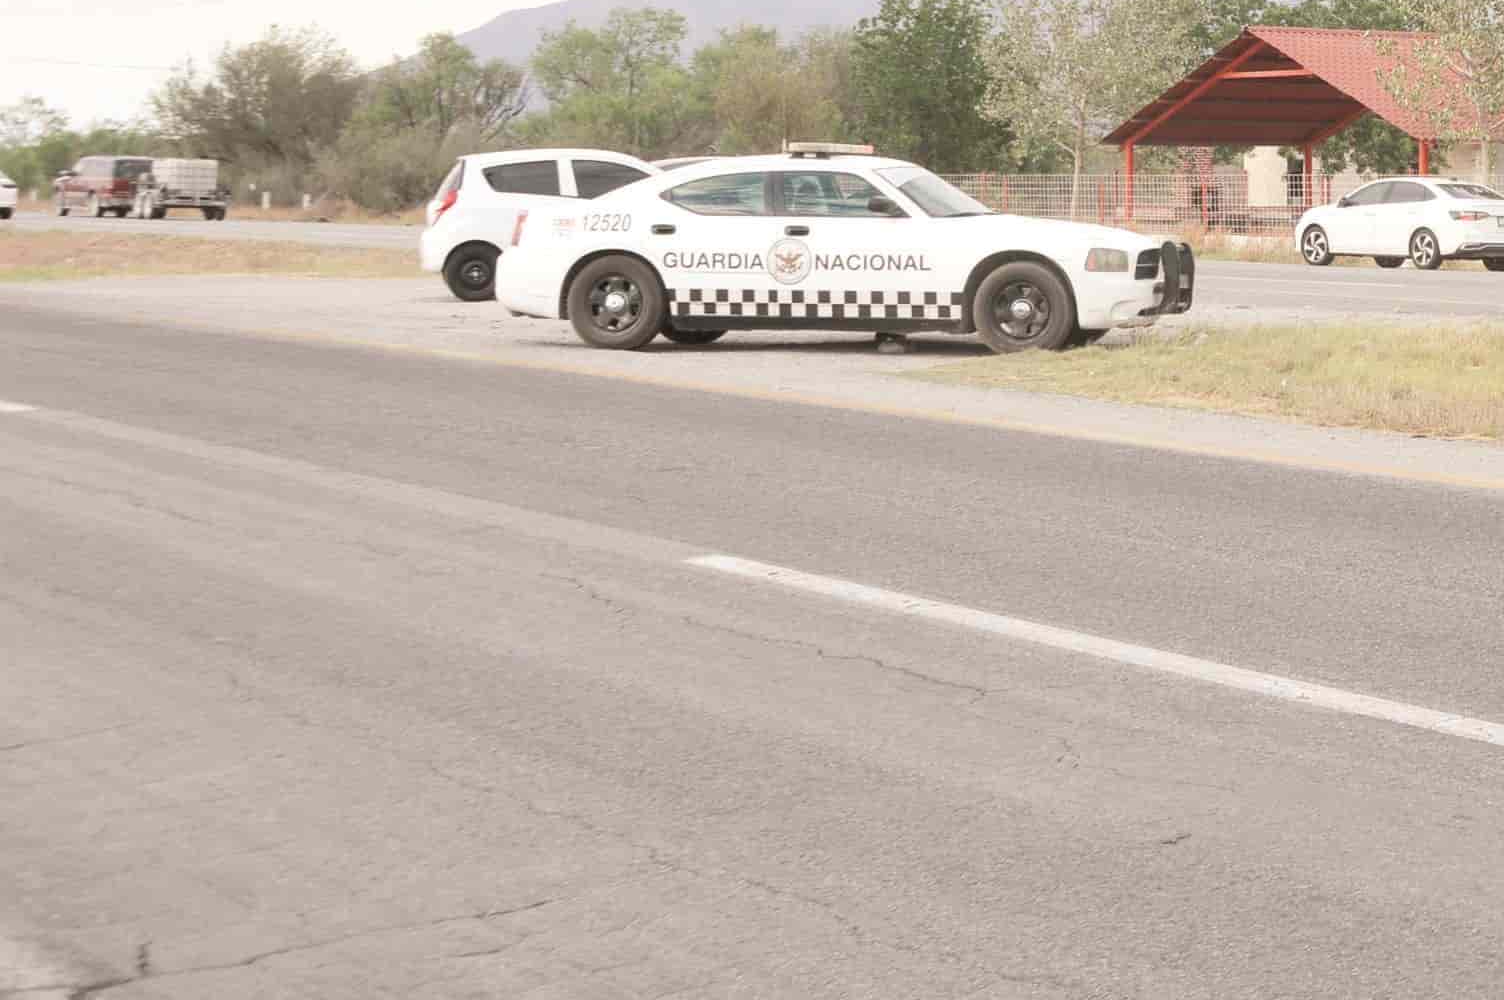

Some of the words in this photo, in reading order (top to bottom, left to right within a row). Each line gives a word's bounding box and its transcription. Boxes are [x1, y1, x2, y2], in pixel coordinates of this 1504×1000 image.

[583, 213, 632, 232] 12520
[662, 252, 765, 270] GUARDIA
[814, 253, 932, 271] NACIONAL
